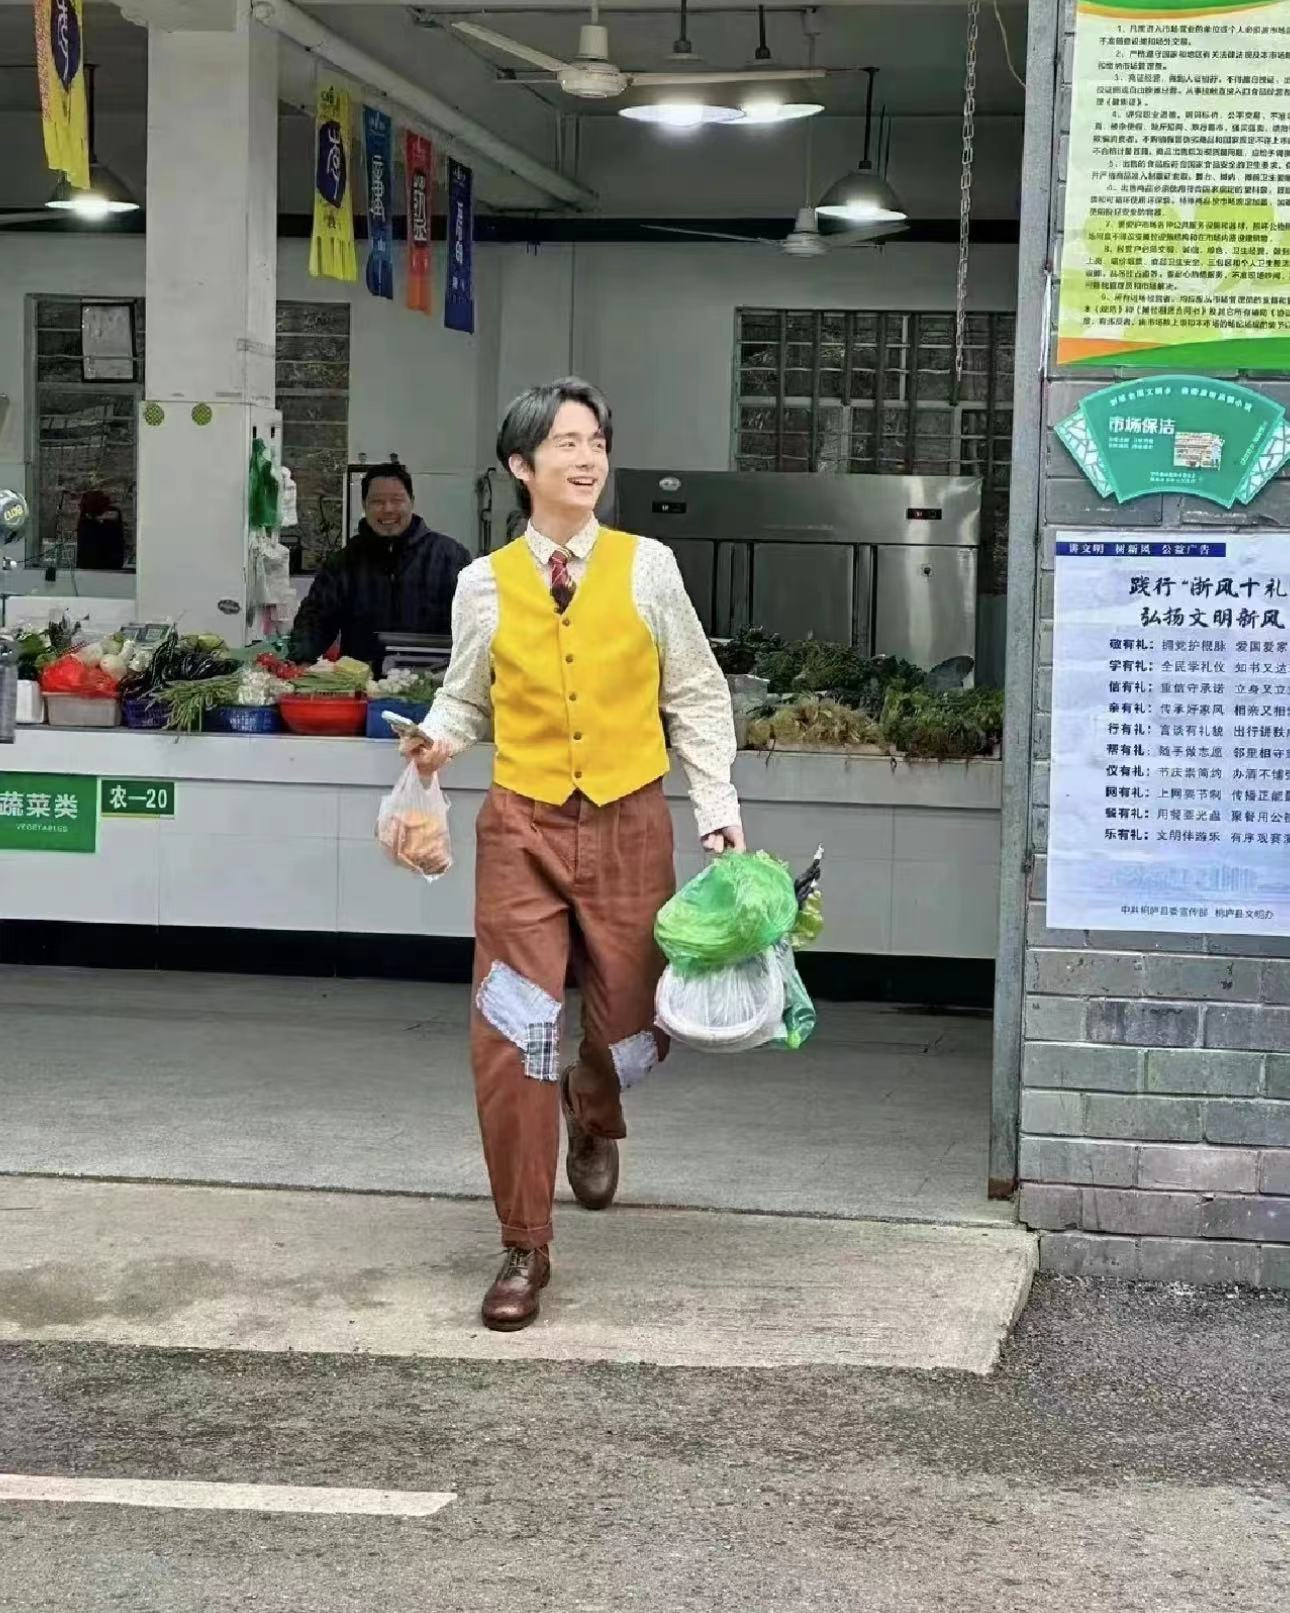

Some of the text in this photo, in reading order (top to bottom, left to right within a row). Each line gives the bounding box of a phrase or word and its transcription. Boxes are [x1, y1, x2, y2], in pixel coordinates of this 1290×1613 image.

[1109, 416, 1176, 435] 市场保洁
[1069, 543, 1210, 556] 讲文明 树新风 公益广告
[1140, 607, 1286, 629] 弘扬文明新风
[1162, 639, 1226, 652] 拥党护根脉
[1236, 640, 1288, 652] 爱国爱家
[1161, 661, 1226, 673] 全民学礼仪
[1161, 683, 1225, 695] 重信守承诺
[1160, 704, 1224, 716] 传承好家风
[1159, 725, 1224, 737] 言谈有礼貌
[1159, 746, 1223, 758] 随手做志愿
[1158, 767, 1223, 779] 节庆崇简约
[1158, 788, 1222, 801] 上网要节制
[0, 790, 78, 819] 蔬菜类
[1157, 809, 1220, 822] 用餐要光盘
